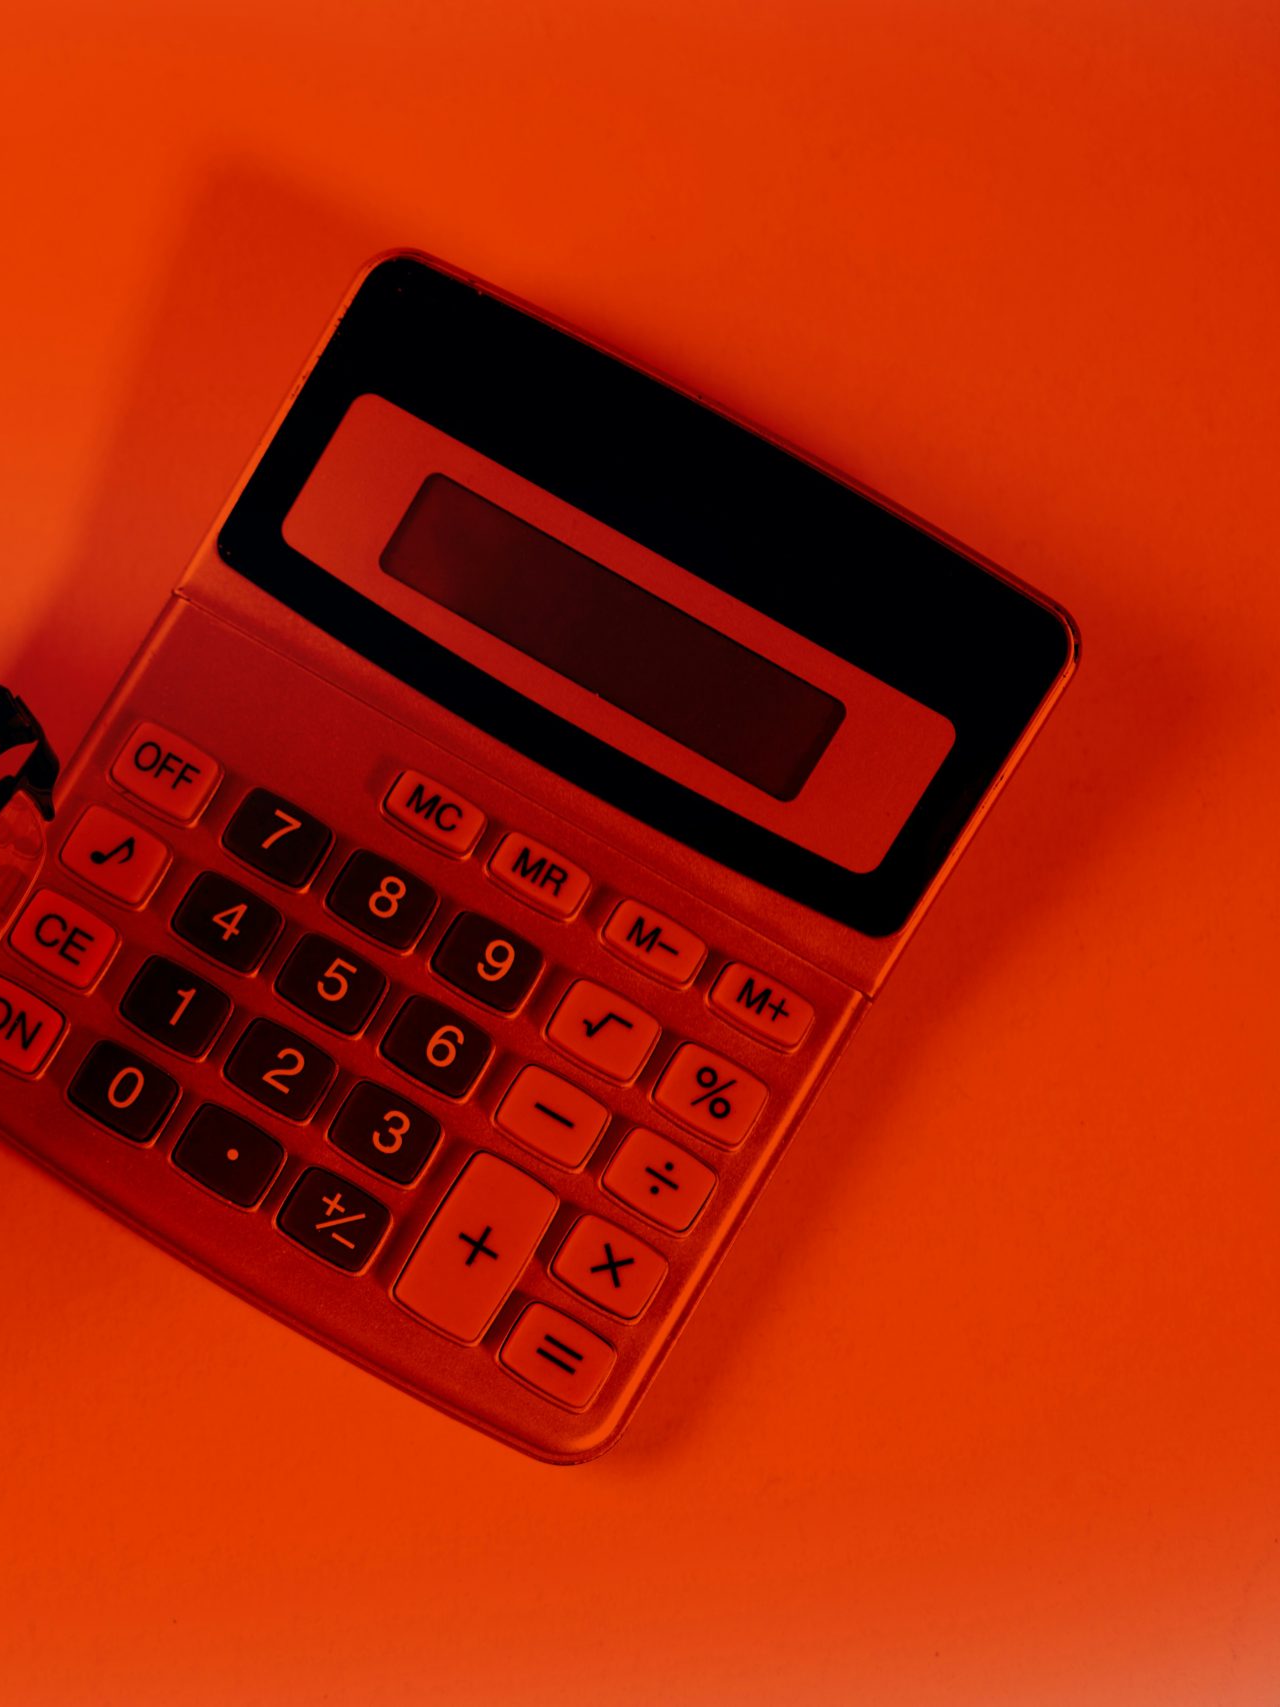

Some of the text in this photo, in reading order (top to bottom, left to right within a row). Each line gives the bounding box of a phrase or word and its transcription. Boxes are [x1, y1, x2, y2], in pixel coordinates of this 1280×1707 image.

[134, 741, 201, 789] OFF
[261, 809, 302, 849] 7
[406, 784, 463, 832] MC
[511, 847, 568, 896] MR
[368, 875, 407, 919] 8
[33, 912, 95, 965] CE
[212, 903, 248, 941] 4
[317, 957, 357, 1002] 5
[476, 939, 515, 982] 9
[169, 988, 196, 1026] 1
[736, 977, 789, 1021] M+
[426, 1025, 465, 1068] 6
[107, 1066, 145, 1109] 0
[262, 1047, 305, 1094] 2
[694, 1065, 732, 1119] %
[372, 1110, 411, 1154] 3
[458, 1226, 498, 1266] +
[536, 1334, 584, 1375] =
